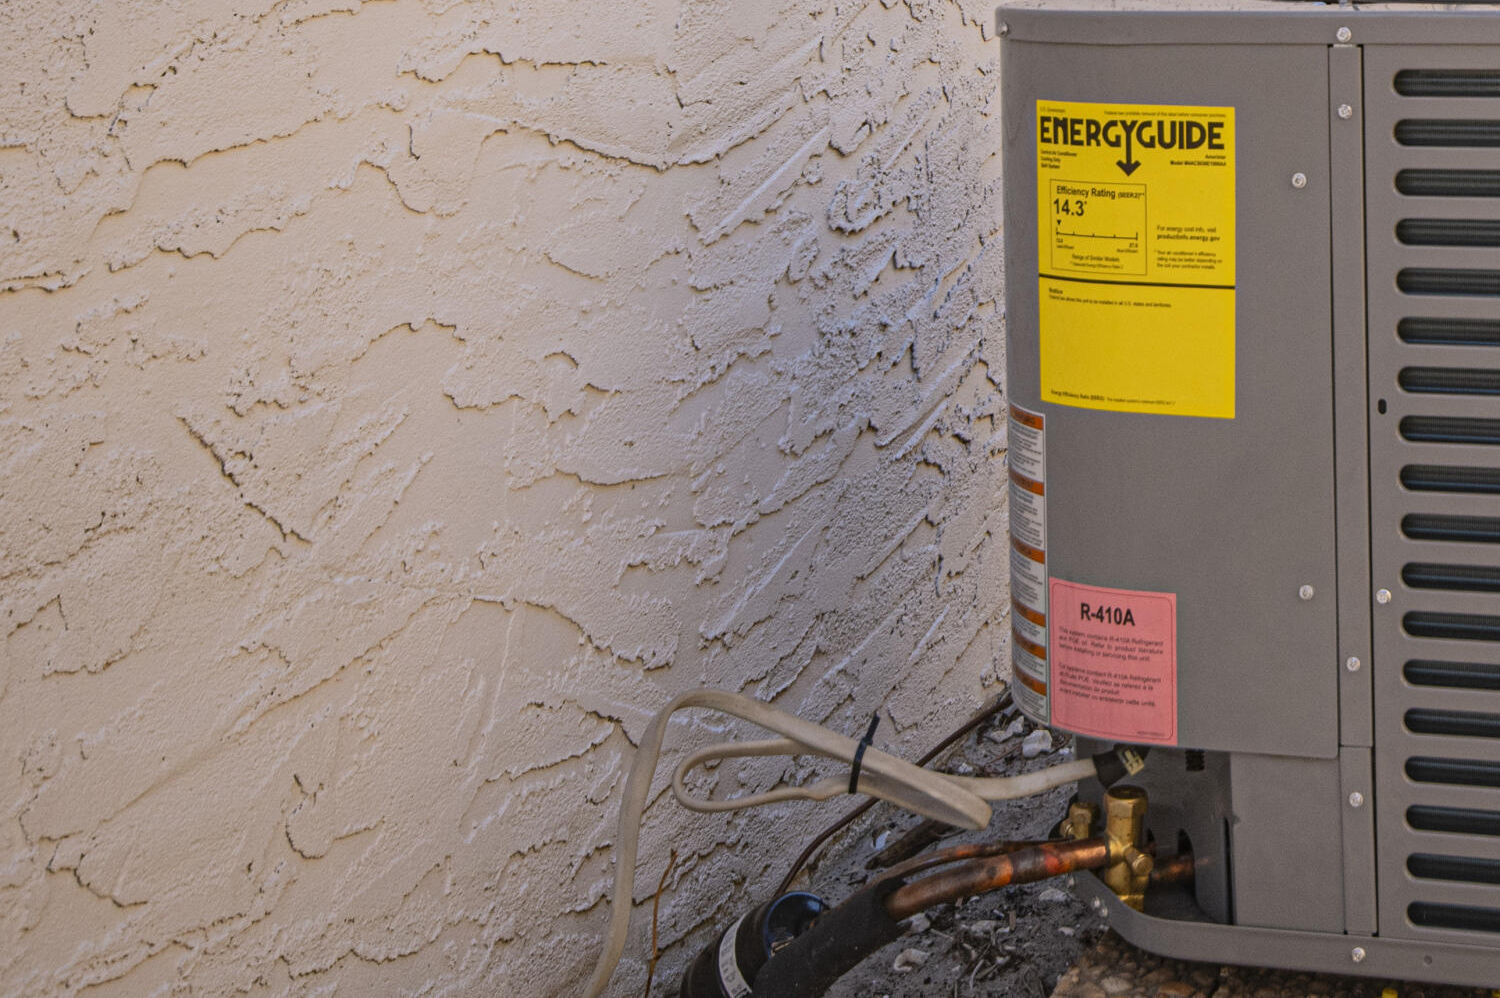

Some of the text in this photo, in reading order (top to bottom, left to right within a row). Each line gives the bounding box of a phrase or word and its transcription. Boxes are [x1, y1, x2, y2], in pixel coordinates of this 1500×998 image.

[1040, 115, 1225, 150] ENERGYGUIDE
[1056, 185, 1089, 198] Efficiency
[1091, 188, 1116, 200] Rating
[1080, 602, 1136, 626] R-410A
